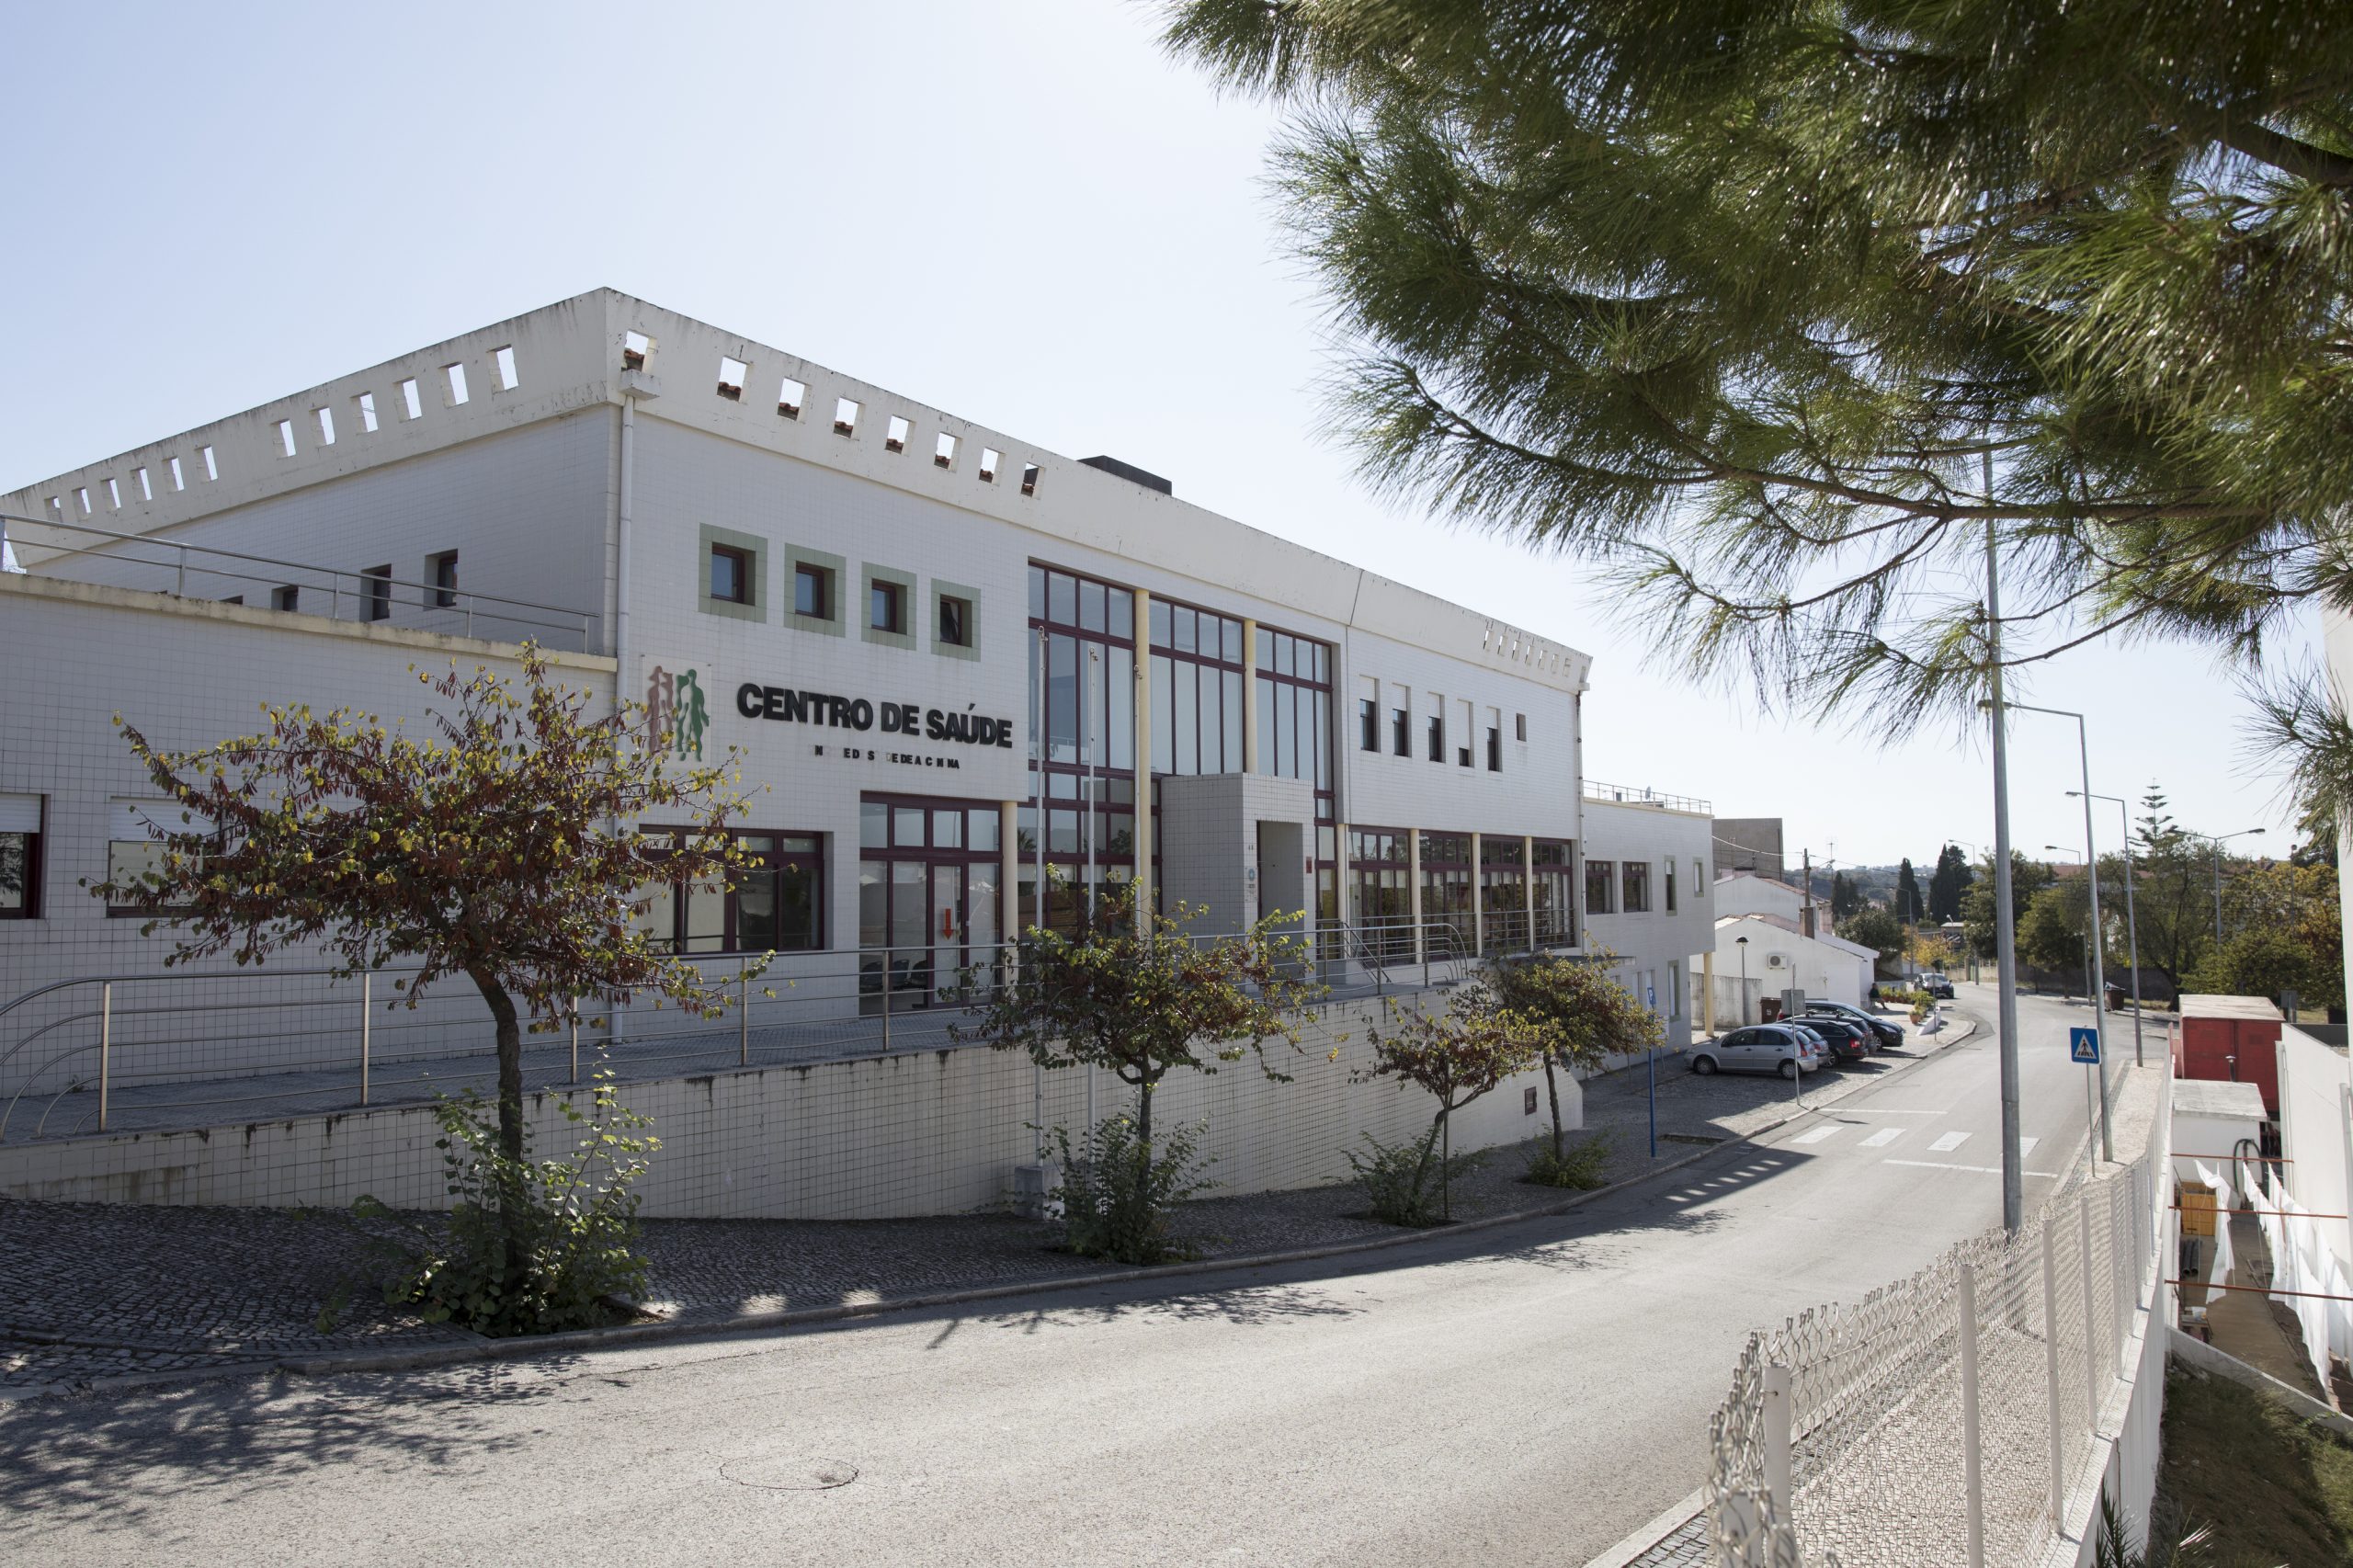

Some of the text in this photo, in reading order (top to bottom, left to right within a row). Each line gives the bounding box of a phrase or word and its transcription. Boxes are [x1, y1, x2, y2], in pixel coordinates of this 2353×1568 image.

[736, 682, 1013, 749] CENTRO DE SAÚDE
